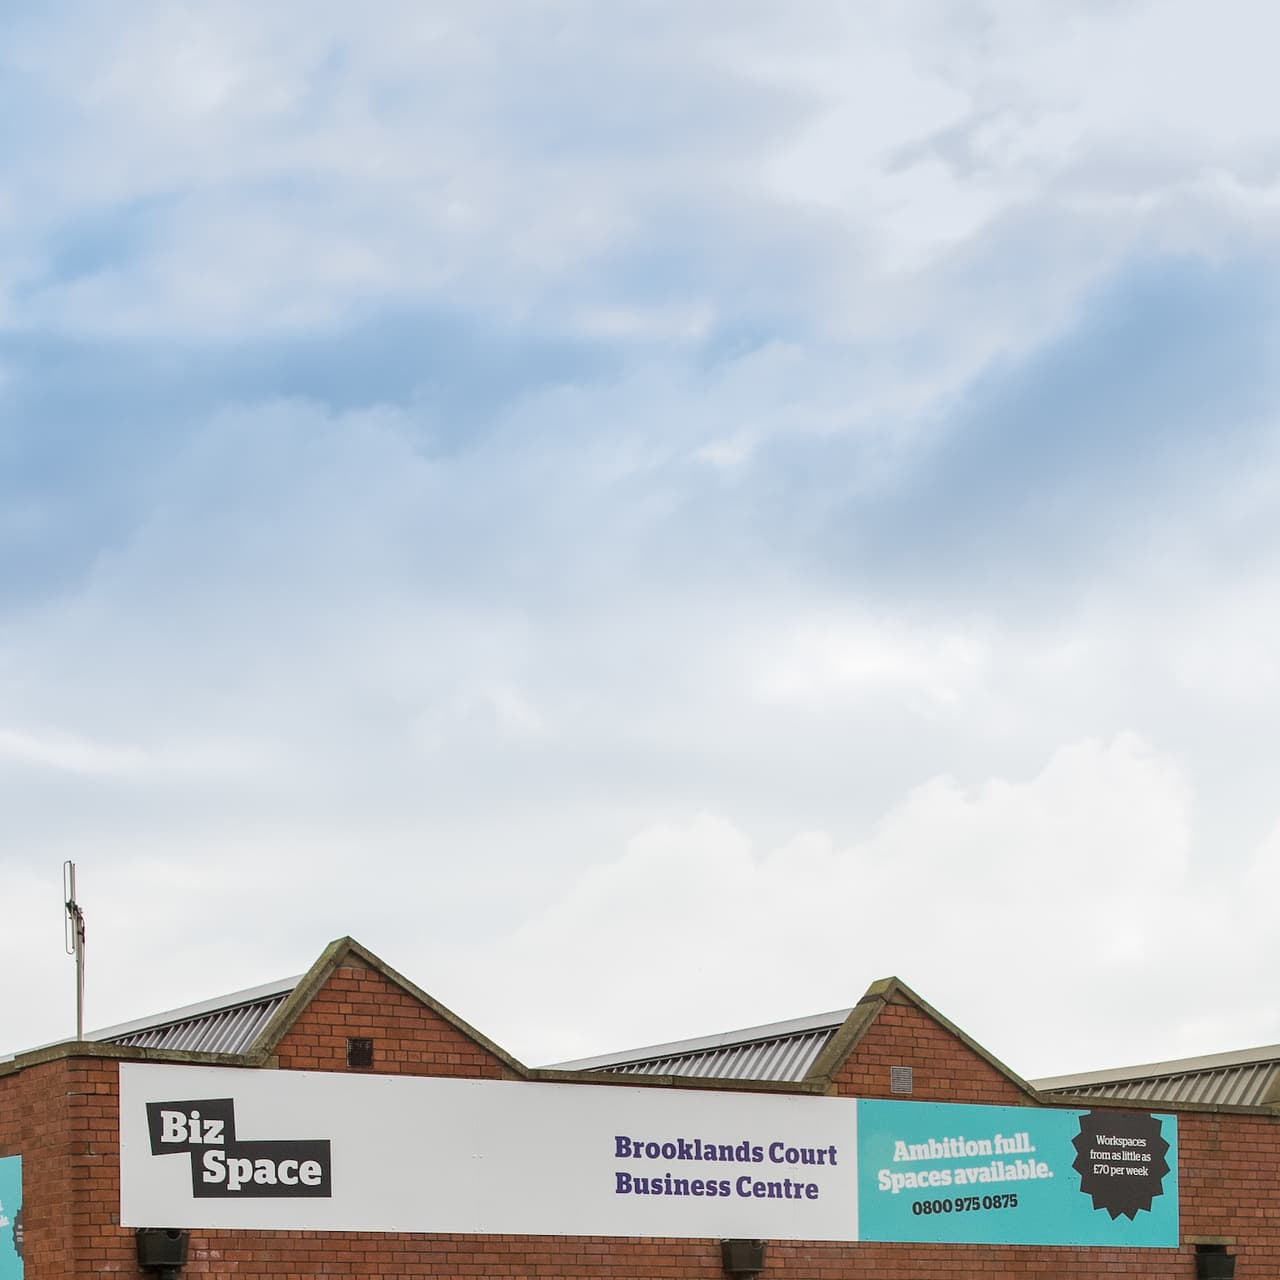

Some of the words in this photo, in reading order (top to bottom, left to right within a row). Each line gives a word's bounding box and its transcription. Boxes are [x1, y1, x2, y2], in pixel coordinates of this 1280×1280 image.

[160, 1110, 225, 1145] Biz
[1096, 1134, 1146, 1148] Workspaces
[615, 1135, 764, 1164] Brooklands
[768, 1141, 839, 1168] Court
[893, 1135, 992, 1162] Ambition
[993, 1132, 1036, 1156] full.
[1090, 1149, 1110, 1161] from
[1111, 1152, 1121, 1161] as
[1122, 1150, 1140, 1162] little
[1141, 1153, 1151, 1162] as
[201, 1151, 323, 1191] Space
[615, 1171, 733, 1198] Business
[736, 1174, 819, 1199] Centre
[878, 1168, 953, 1194] Spaces
[954, 1159, 1054, 1185] available.
[1093, 1164, 1109, 1175] £70
[1110, 1166, 1125, 1178] per
[1126, 1164, 1149, 1177] week
[912, 1197, 953, 1216] 0800
[954, 1196, 981, 1213] 975
[982, 1193, 1018, 1210] 0875
